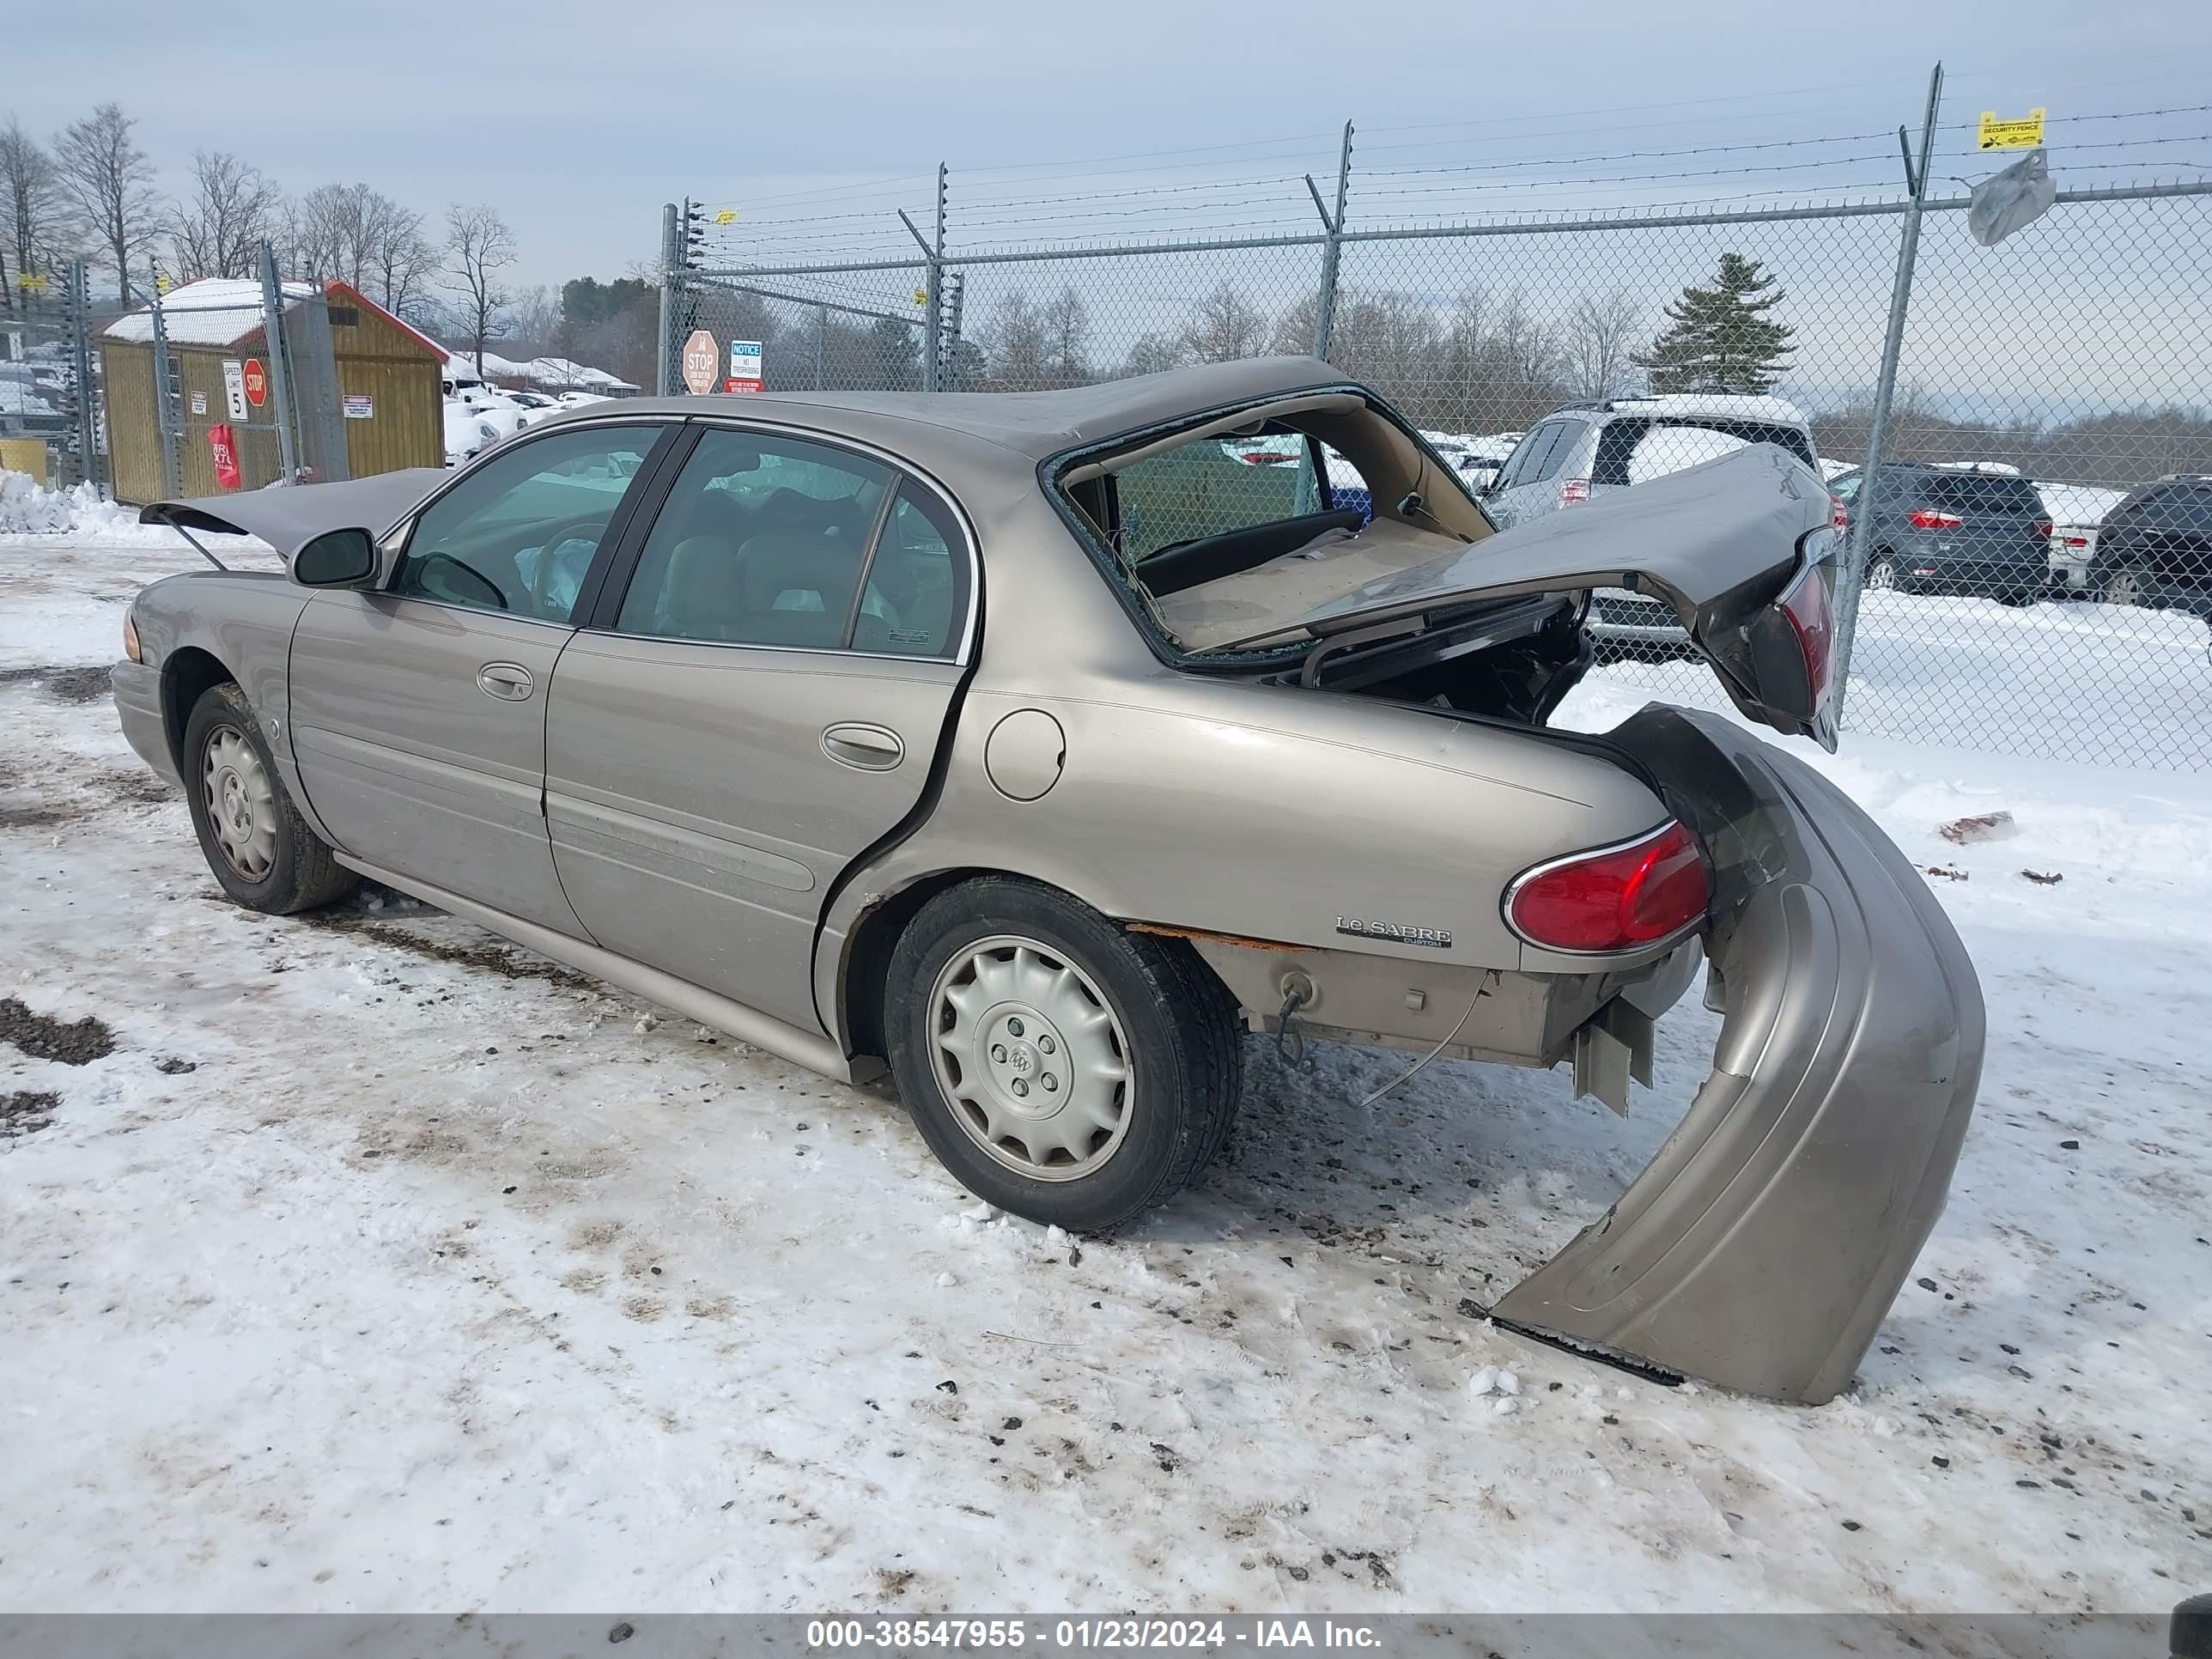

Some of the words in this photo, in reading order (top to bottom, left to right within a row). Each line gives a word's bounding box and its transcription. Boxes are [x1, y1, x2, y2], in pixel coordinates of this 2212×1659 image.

[733, 344, 760, 356] NOTICE
[689, 353, 714, 370] STOP
[743, 358, 750, 367] NO
[224, 367, 240, 376] SPEED
[228, 380, 240, 389] LIMIT
[246, 374, 263, 392] STOP
[233, 392, 241, 414] 5
[1335, 915, 1363, 931] Le
[1370, 921, 1451, 942] SABRE
[1403, 937, 1443, 947] CUSTOM
